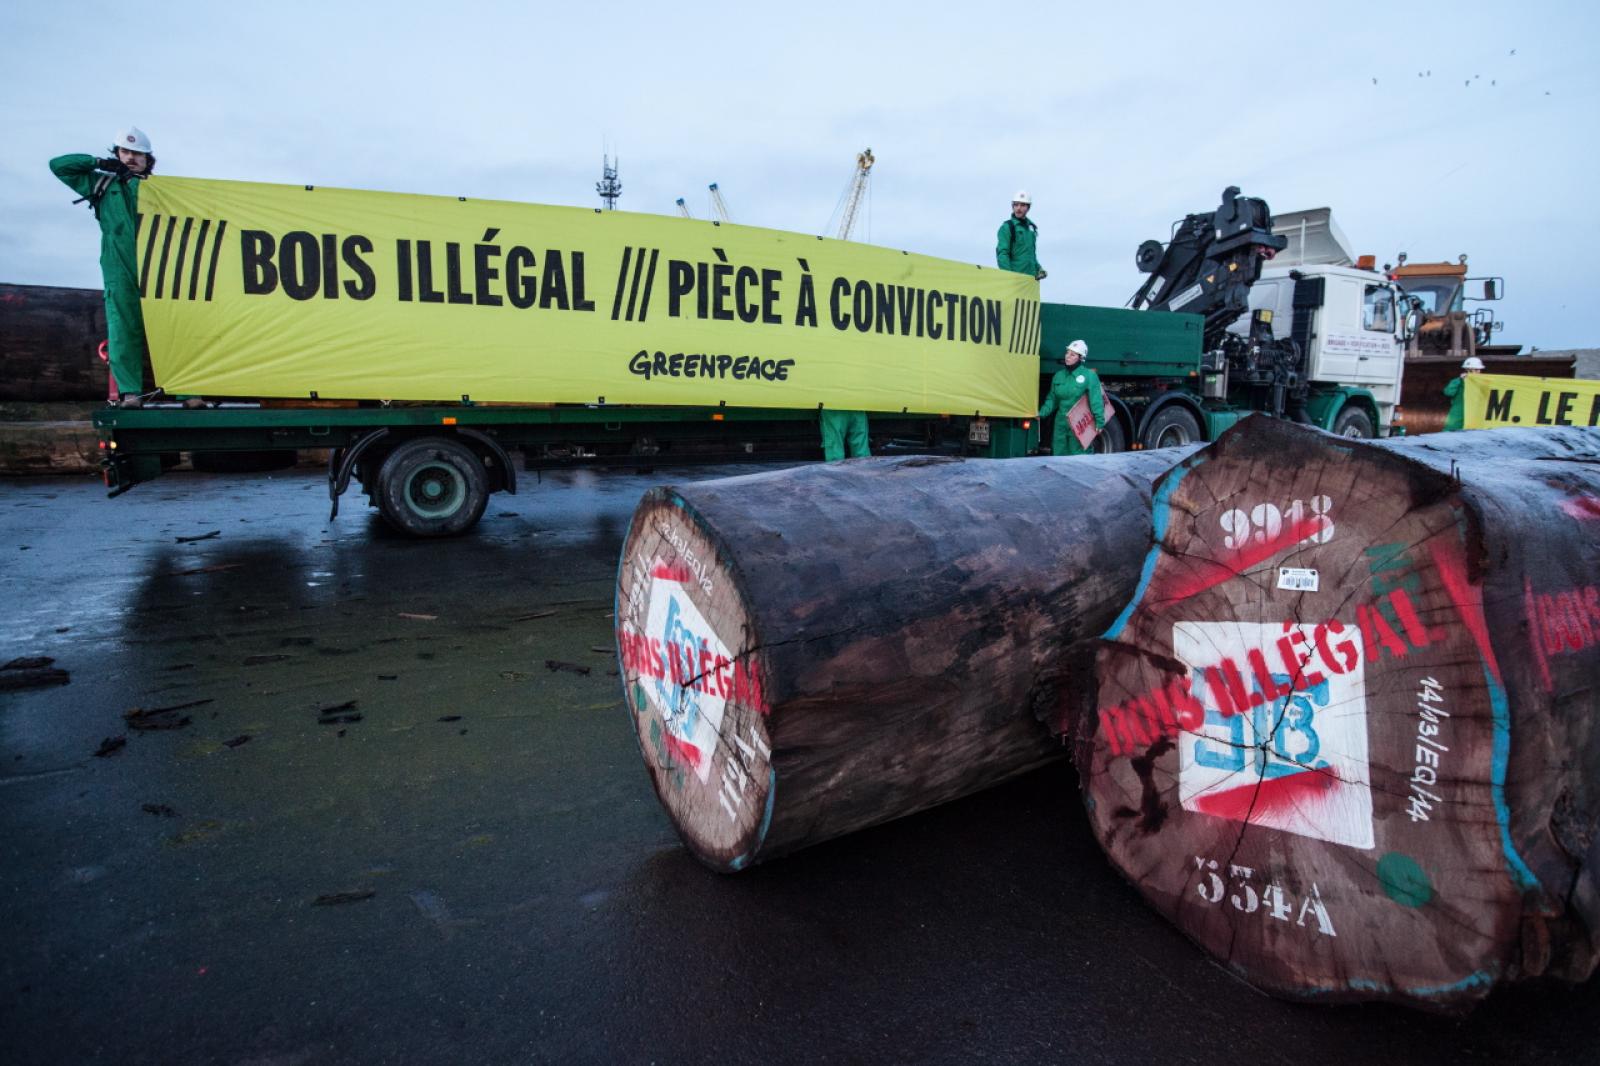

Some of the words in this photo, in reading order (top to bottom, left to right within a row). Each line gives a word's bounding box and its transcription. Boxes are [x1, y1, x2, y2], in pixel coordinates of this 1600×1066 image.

[241, 230, 376, 300] BOIS
[397, 228, 595, 312] ILLÉGAL
[668, 247, 782, 324] PIÈCE
[795, 257, 818, 327] À
[830, 277, 1002, 346] CONVICTION
[629, 350, 795, 381] GREENPEACE
[1485, 389, 1520, 423] M.
[1536, 391, 1578, 425] LE
[1220, 495, 1335, 549] 9918
[1204, 587, 1446, 718] ILLÉGAL
